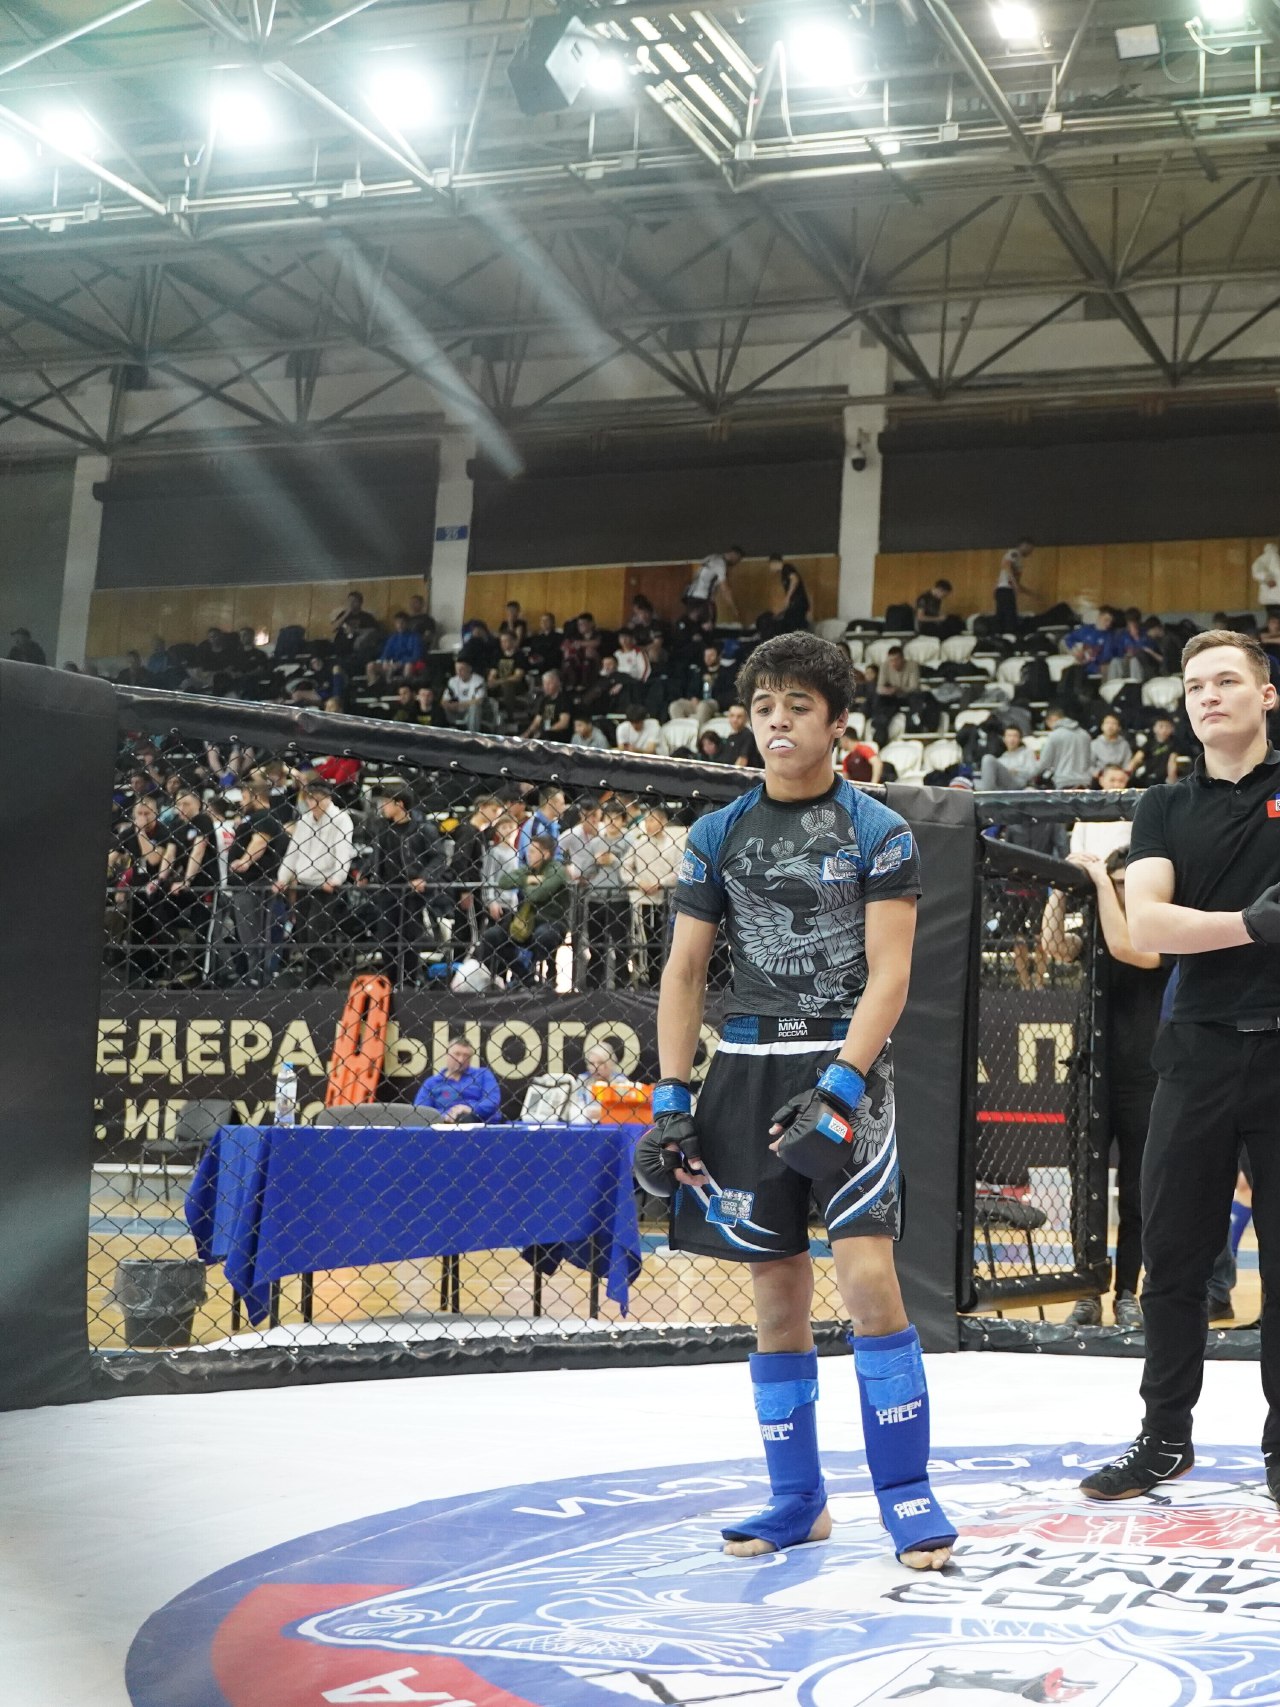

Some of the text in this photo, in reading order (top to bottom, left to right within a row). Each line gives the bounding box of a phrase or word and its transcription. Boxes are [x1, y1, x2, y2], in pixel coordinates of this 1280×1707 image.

[779, 1021, 808, 1031] ММА
[778, 1030, 808, 1038] РОССИИ
[879, 1410, 918, 1426] HILL
[893, 1498, 931, 1511] GREEN
[897, 1504, 931, 1519] HILL
